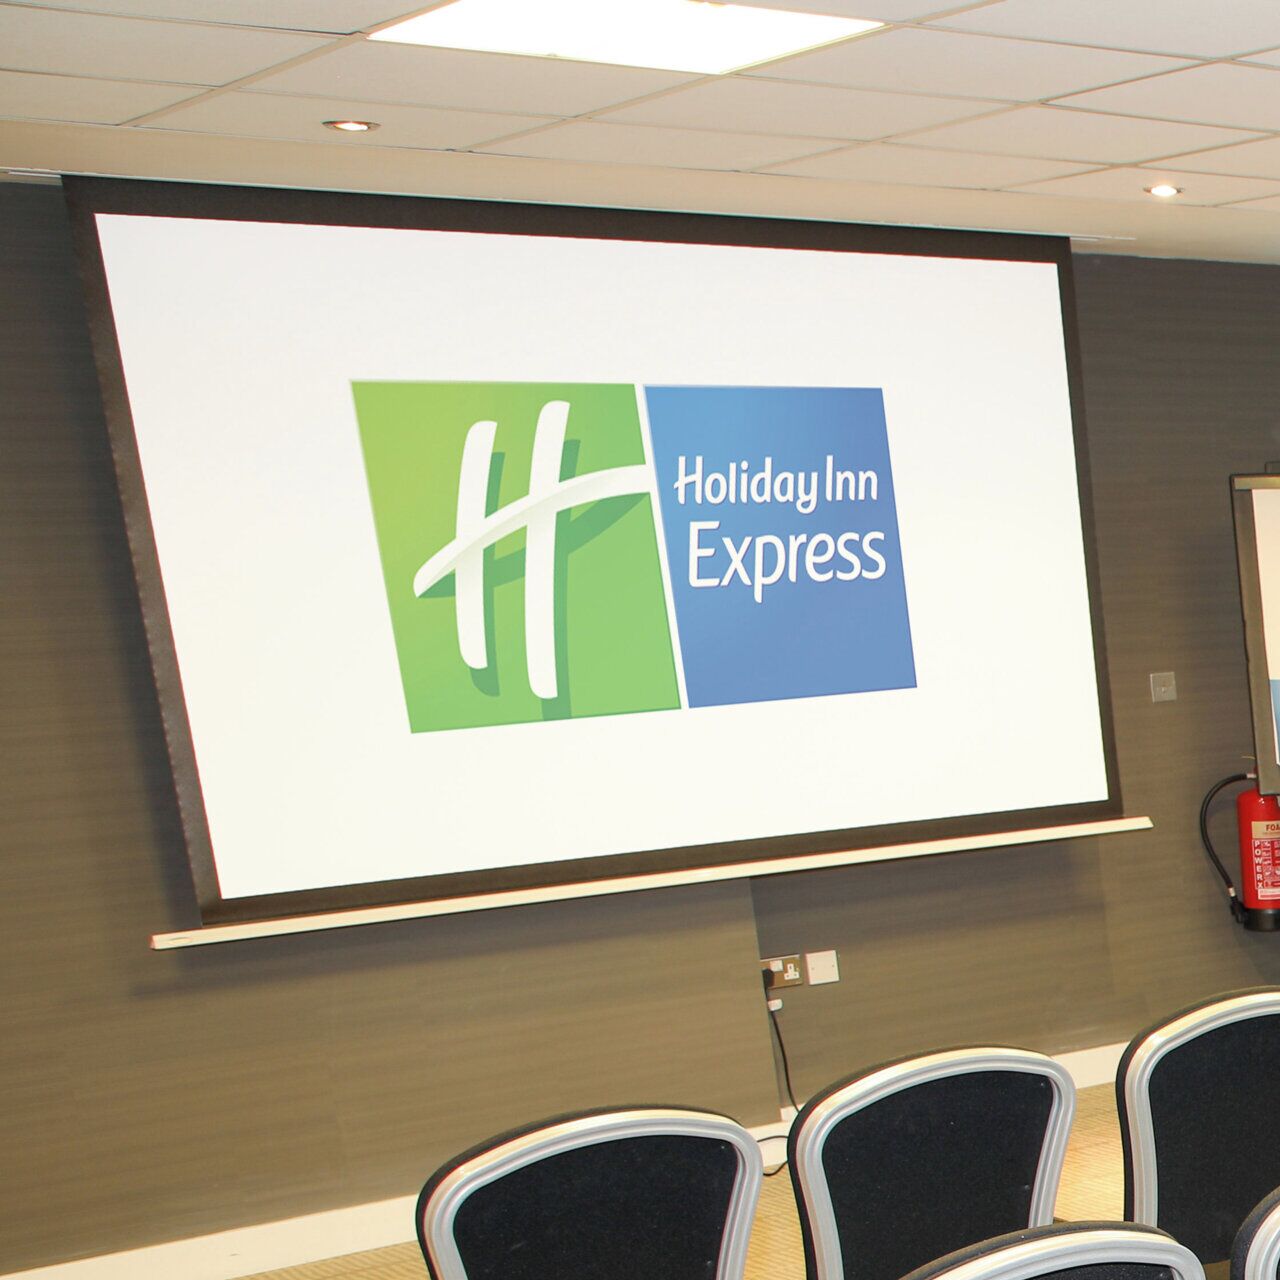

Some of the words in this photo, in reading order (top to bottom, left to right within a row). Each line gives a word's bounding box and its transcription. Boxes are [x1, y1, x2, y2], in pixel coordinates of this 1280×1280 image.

[673, 455, 818, 514] Holiday
[826, 455, 878, 501] Inn
[688, 520, 887, 604] Express
